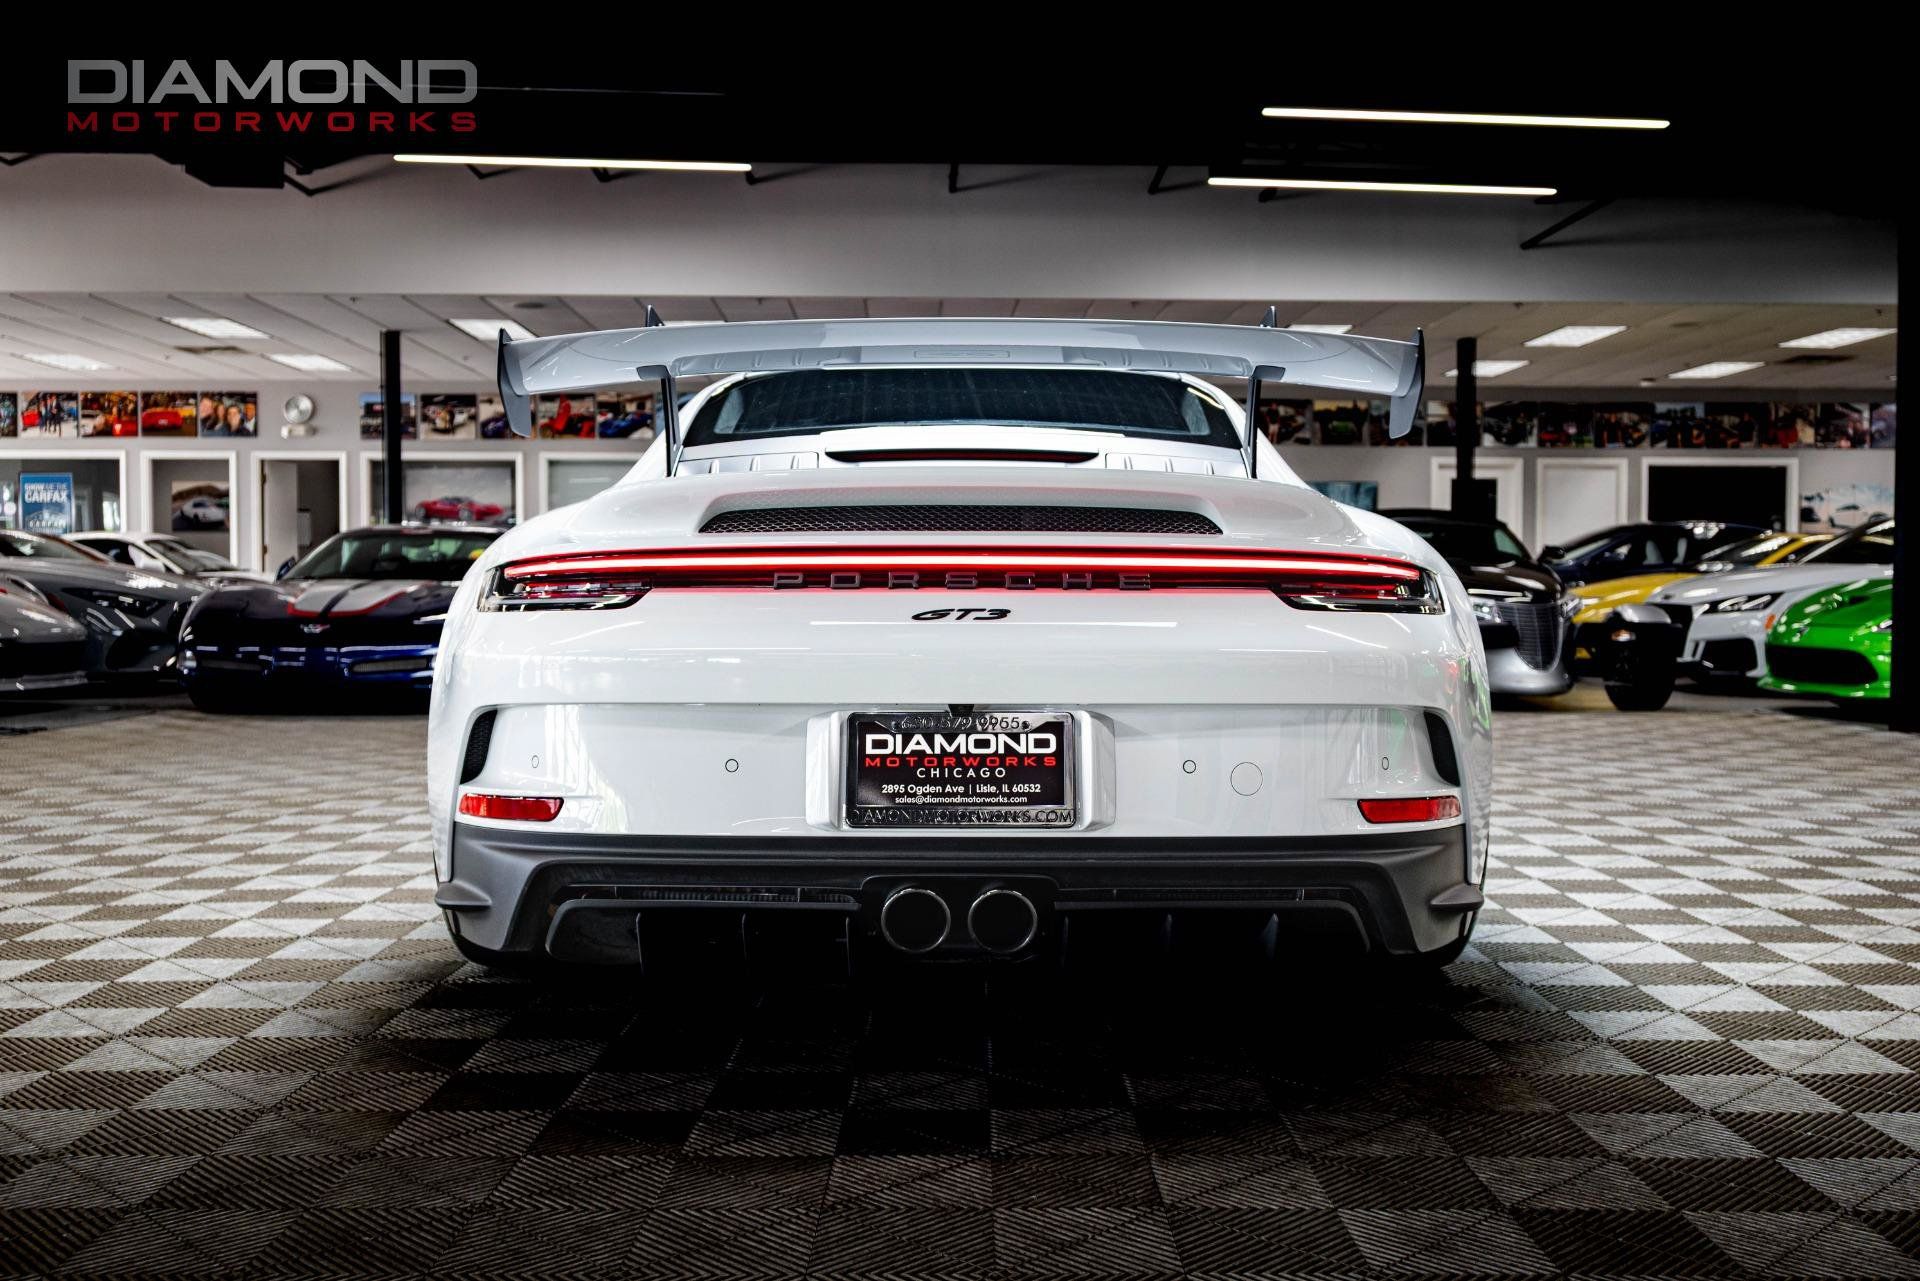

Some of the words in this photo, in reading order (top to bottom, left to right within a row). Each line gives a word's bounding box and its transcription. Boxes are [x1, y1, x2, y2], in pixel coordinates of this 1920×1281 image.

[773, 572, 1151, 590] PORSCHE
[911, 608, 1013, 621] GT3
[865, 733, 1057, 755] DIAMOND
[865, 756, 1057, 768] MOTORWORKS
[916, 767, 1006, 778] CHICAGO
[881, 784, 905, 794] 2895
[907, 784, 942, 795] Ogden
[944, 784, 965, 793] Ave
[976, 783, 1000, 794] Lisle,
[1002, 783, 1010, 793] IL
[1012, 783, 1041, 793] 60532
[895, 795, 1028, 805] sales@diamondmotorworks.com
